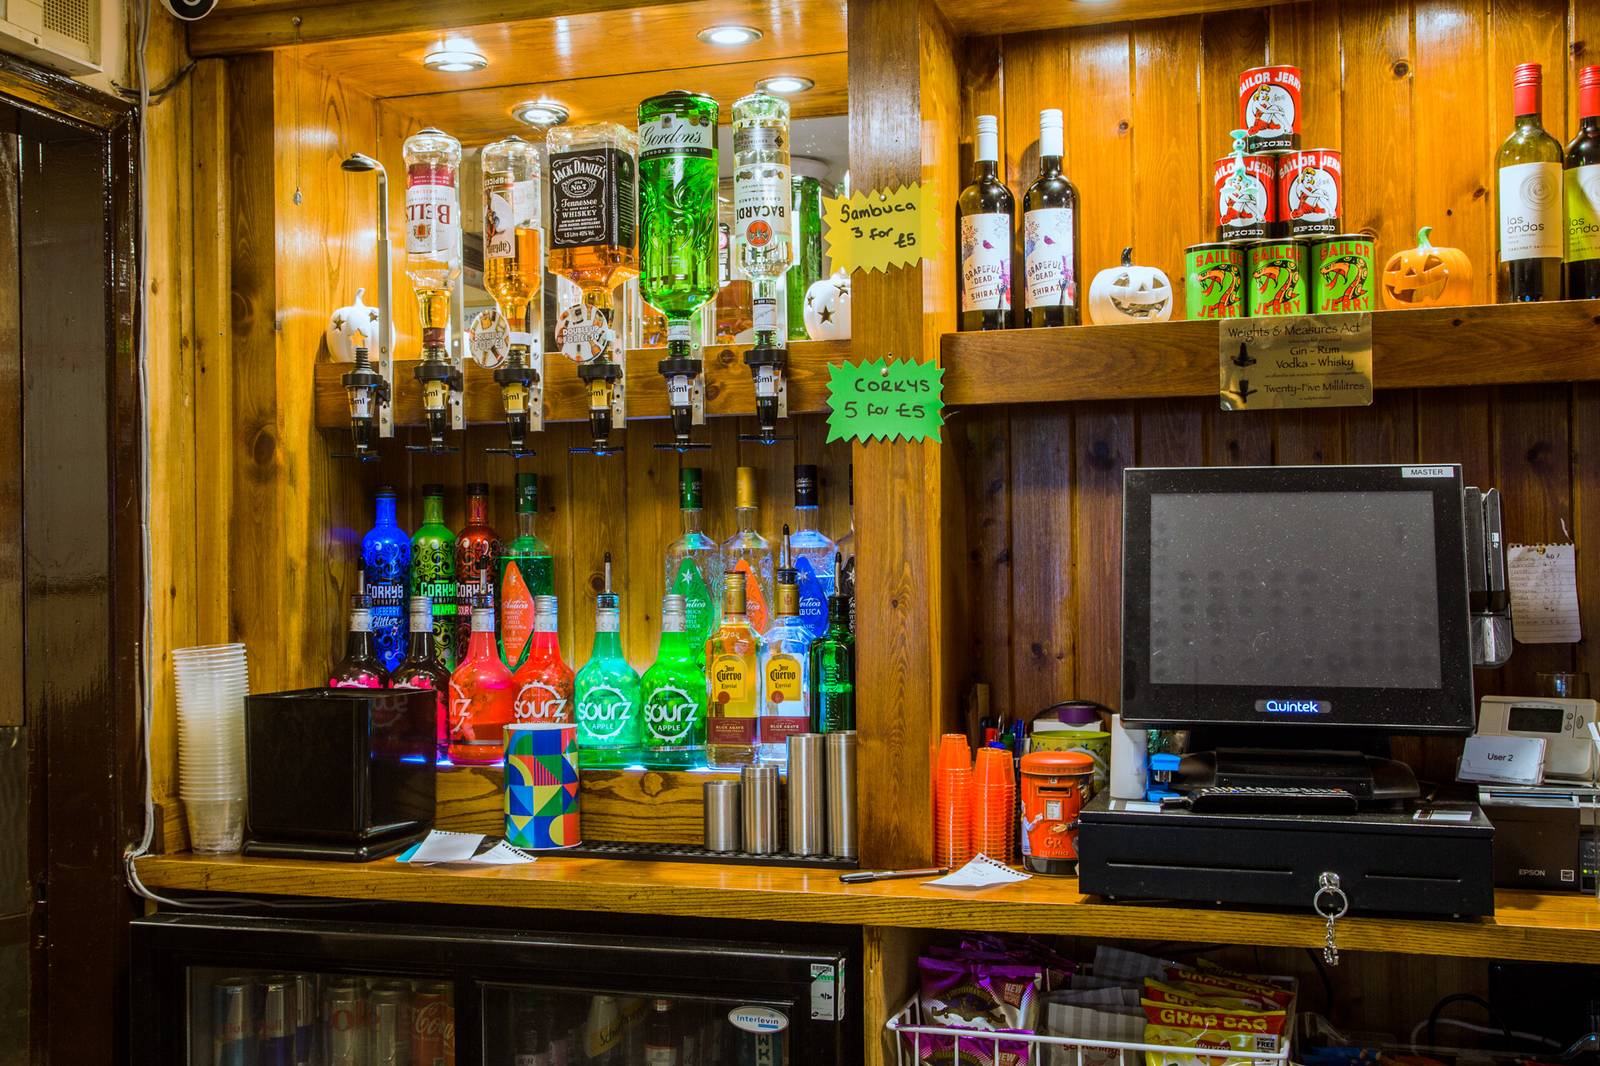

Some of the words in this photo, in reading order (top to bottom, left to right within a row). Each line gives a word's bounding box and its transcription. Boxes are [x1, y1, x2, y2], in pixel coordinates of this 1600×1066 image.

[641, 125, 702, 147] Gordon's
[1250, 140, 1292, 151] SPICED
[1322, 154, 1340, 176] JERR
[552, 163, 574, 184] JACK
[574, 160, 608, 181] DANIEL'S
[562, 210, 598, 218] WHISKEY
[840, 202, 916, 224] Sambuca
[1506, 216, 1524, 226] las
[1223, 229, 1264, 238] SPICED
[1294, 224, 1336, 233] SPICED
[1506, 222, 1544, 234] ondas
[1568, 224, 1600, 235] onda
[851, 227, 864, 238] 3
[869, 227, 894, 240] for
[894, 232, 916, 248] £5
[1320, 243, 1370, 262] SAILOR
[974, 274, 993, 285] DEAD
[1035, 271, 1054, 282] DEAD
[971, 288, 999, 301] SHIRAZ
[1032, 284, 1060, 297] SHIRAZ
[1254, 300, 1301, 315] JERRY
[1322, 297, 1370, 312] JERRY
[1228, 324, 1270, 343] Weights
[1284, 324, 1338, 336] Measures
[1340, 322, 1360, 333] Act
[1290, 347, 1308, 356] Gin
[1318, 346, 1340, 354] Rum
[1276, 358, 1308, 369] Vodka
[1318, 356, 1354, 370] Whisky
[854, 378, 930, 393] CORKYS
[1264, 382, 1321, 396] Twenty-Five
[1322, 380, 1366, 391] Millilitres
[844, 401, 858, 418] 5
[866, 403, 890, 417] for
[896, 402, 926, 418] £5
[366, 583, 404, 599] CORKY'S
[686, 598, 706, 609] ntica
[716, 670, 742, 682] Cuervo
[770, 668, 796, 682] Cuervo
[1266, 700, 1318, 712] Quintek
[1487, 752, 1507, 762] User
[1508, 754, 1514, 762] 2
[1518, 868, 1546, 876] EPSON
[1005, 982, 1023, 994] NEW
[1160, 1009, 1218, 1026] GRAB
[1224, 1016, 1268, 1030] BAG
